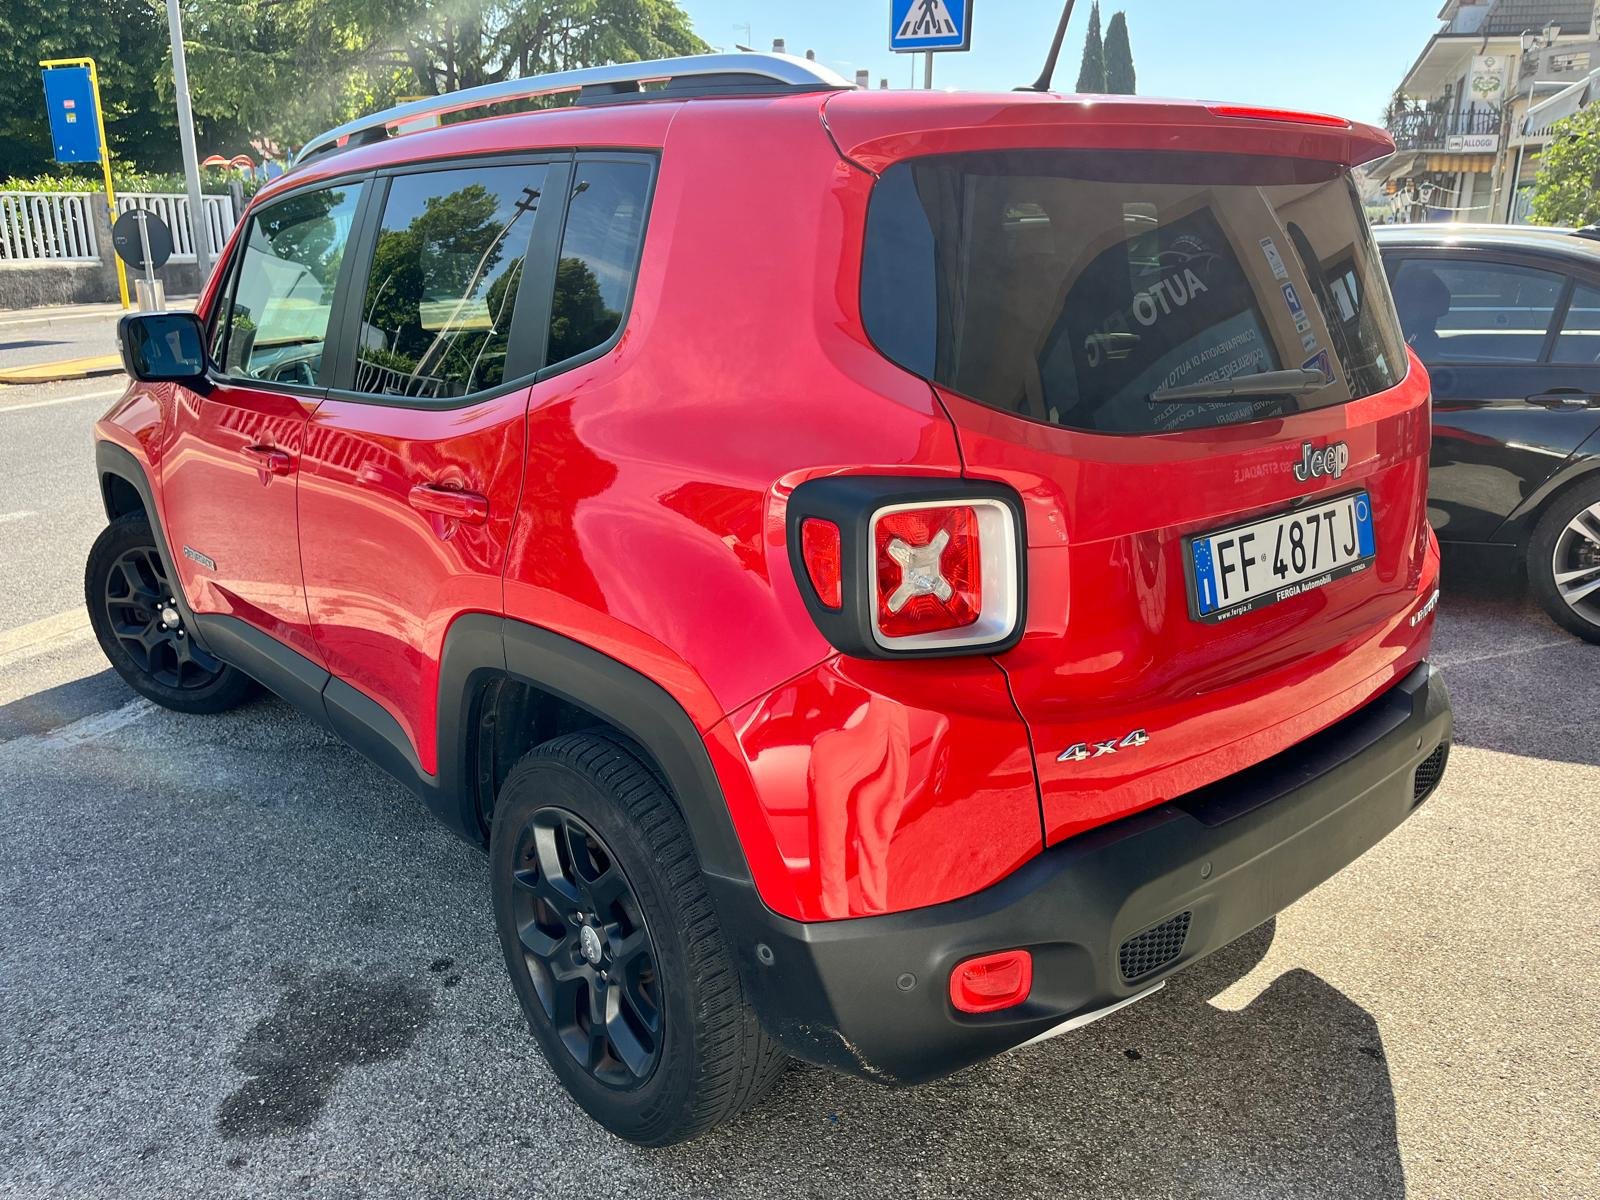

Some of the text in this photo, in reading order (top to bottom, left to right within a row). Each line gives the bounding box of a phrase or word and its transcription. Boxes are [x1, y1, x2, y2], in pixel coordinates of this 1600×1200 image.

[1463, 139, 1492, 148] ALLOGGI
[1294, 441, 1349, 482] Jeep
[1217, 505, 1356, 600] FF 487TJ
[1276, 574, 1332, 603] FERGIA Automobili
[1217, 603, 1253, 621] www.fergia.it
